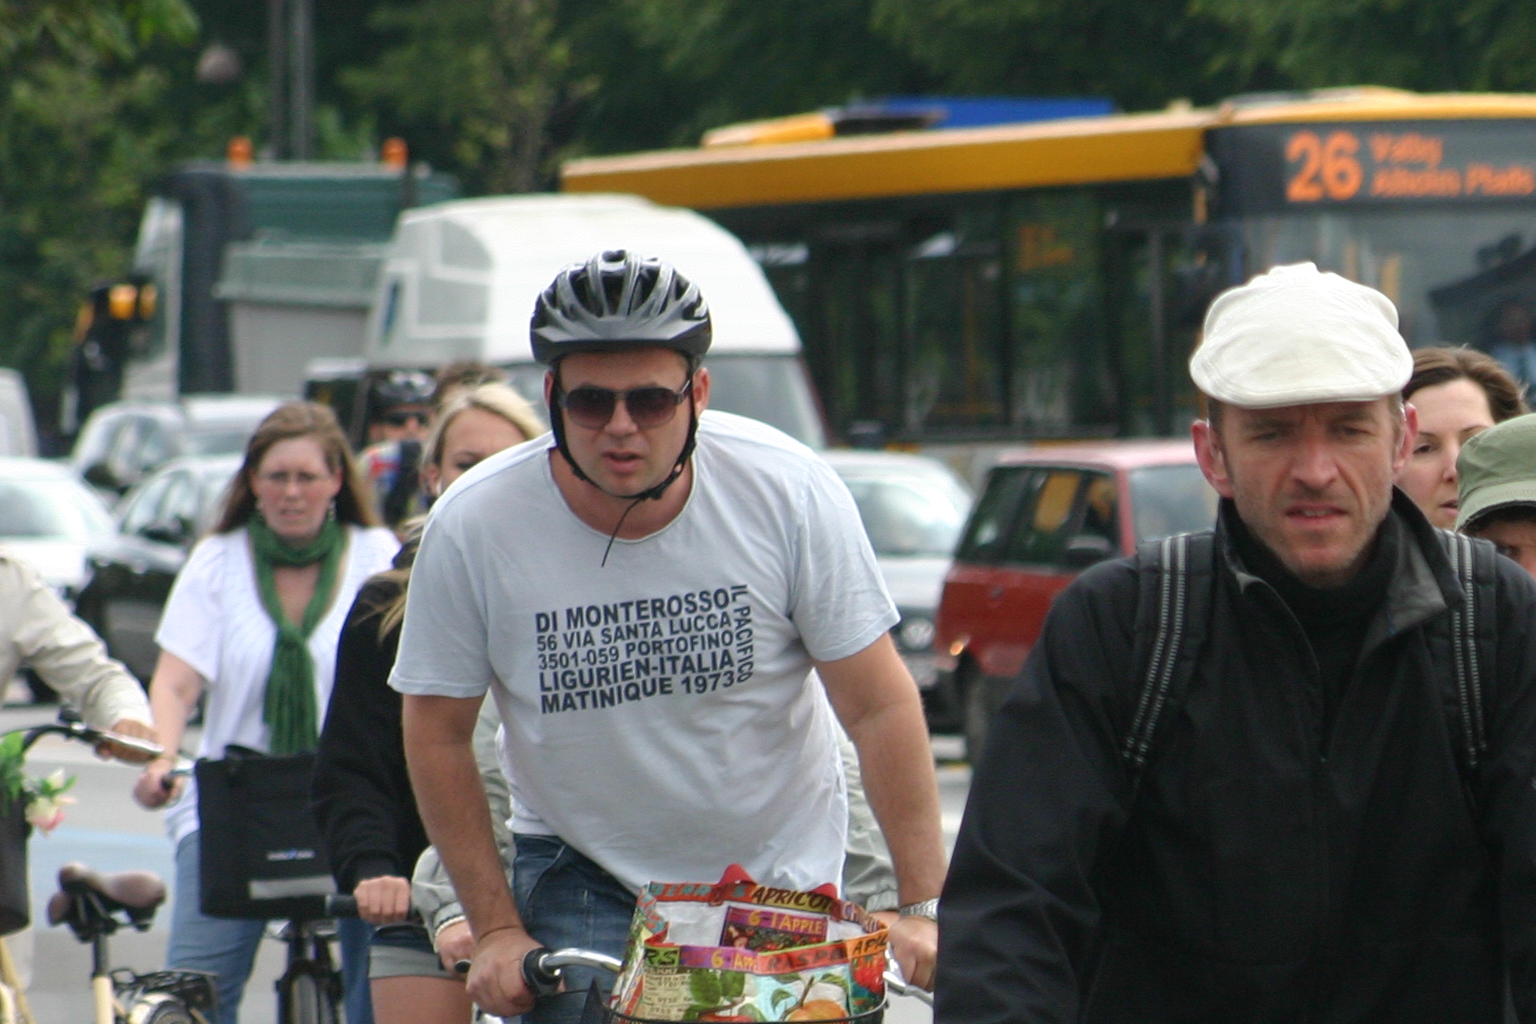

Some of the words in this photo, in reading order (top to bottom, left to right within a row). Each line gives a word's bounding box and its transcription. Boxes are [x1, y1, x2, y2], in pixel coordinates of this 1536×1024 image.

[1286, 129, 1363, 201] 26
[535, 611, 558, 633] DI
[566, 588, 730, 630] MONTEROSSO
[731, 584, 748, 602] IL
[537, 634, 557, 652] 56
[563, 630, 595, 650] VIA
[601, 623, 663, 646] SANTA
[669, 612, 732, 635] LUCCA
[538, 646, 620, 670] 3501-059
[626, 630, 733, 659] PORTOFINO
[734, 605, 754, 683] PACIFICO
[539, 650, 734, 692] LIGURIEN-ITALIA
[541, 677, 673, 714] MATINIQUE
[681, 671, 734, 694] 1973
